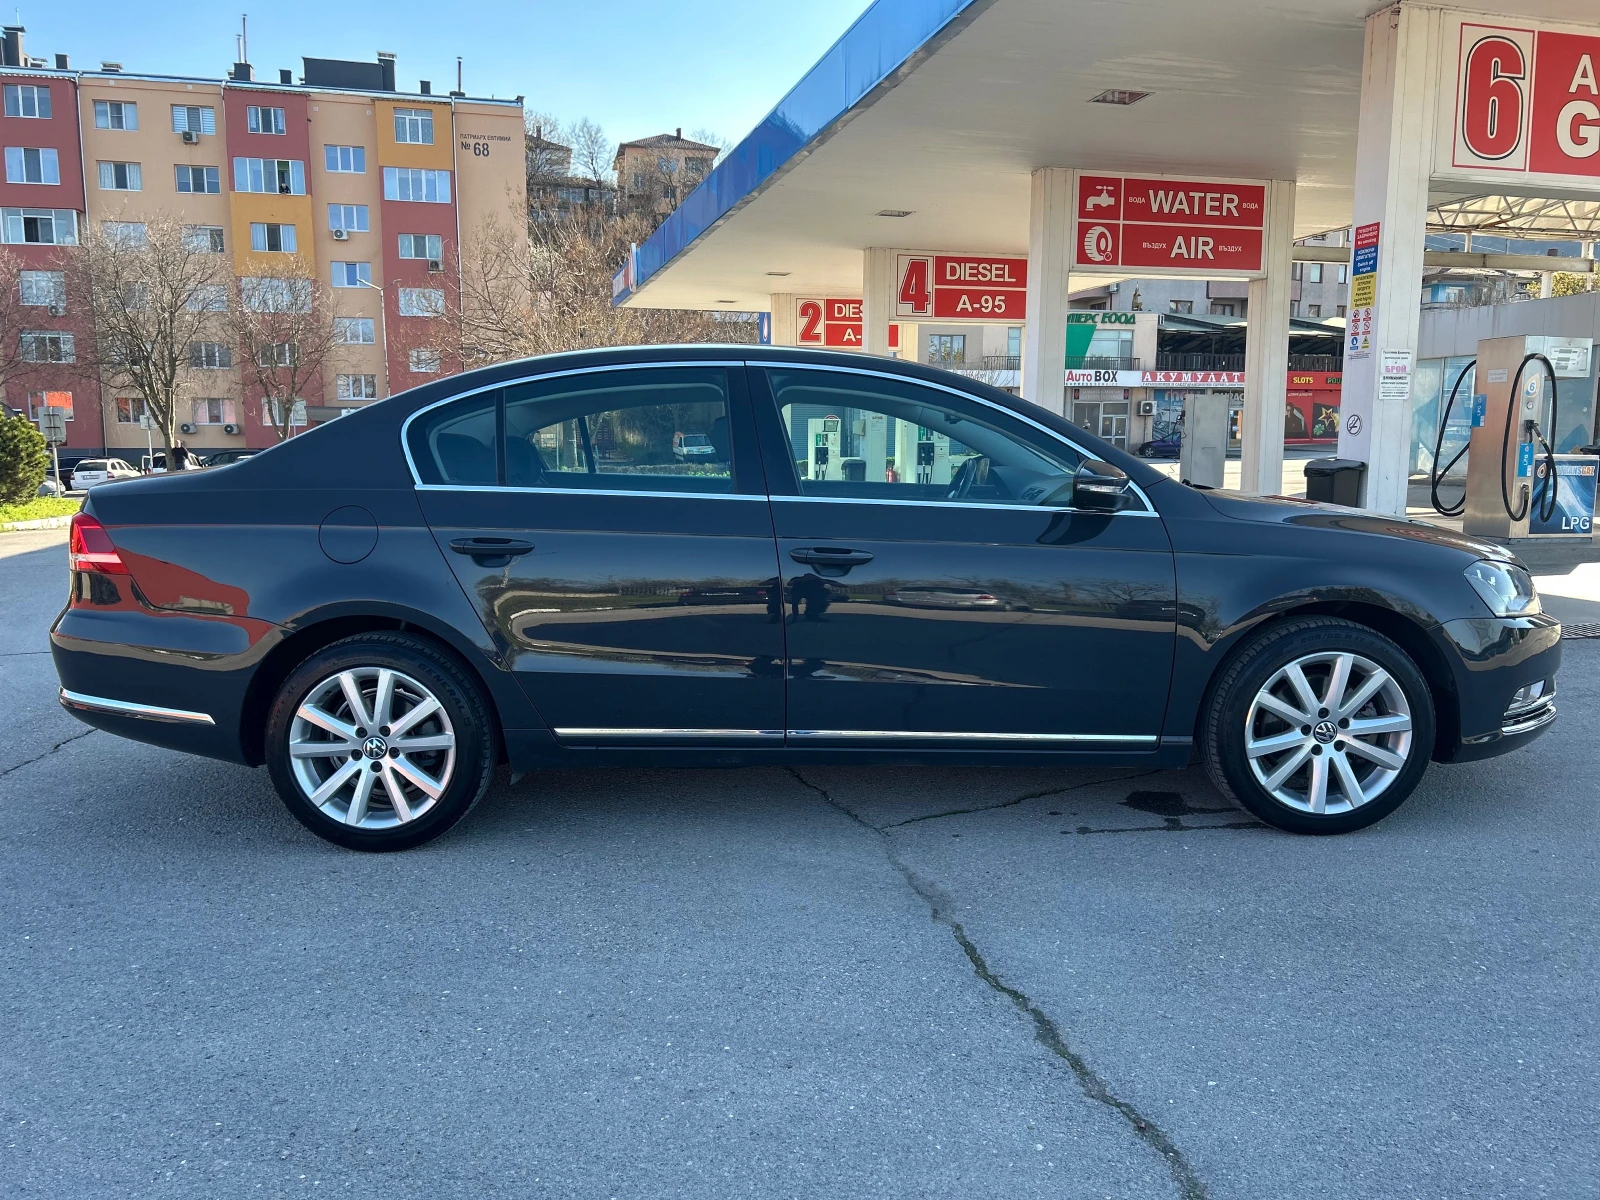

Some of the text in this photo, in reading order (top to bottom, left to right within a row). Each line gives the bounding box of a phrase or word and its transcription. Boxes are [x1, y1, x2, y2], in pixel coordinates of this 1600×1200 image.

[1462, 35, 1526, 160] 6
[474, 142, 490, 157] 68
[1149, 190, 1240, 217] WATER
[1170, 236, 1215, 260] AIR
[946, 262, 1016, 282] DIESEL
[899, 259, 931, 313] 4
[956, 294, 1006, 313] A-95
[799, 301, 822, 342] 2
[1101, 312, 1136, 324] ЕООД
[1094, 371, 1118, 382] BOX
[1143, 372, 1245, 382] АКУМУЛАТ
[1529, 382, 1535, 391] 6
[1562, 516, 1590, 530] LPG
[417, 663, 465, 717] GENERAL
